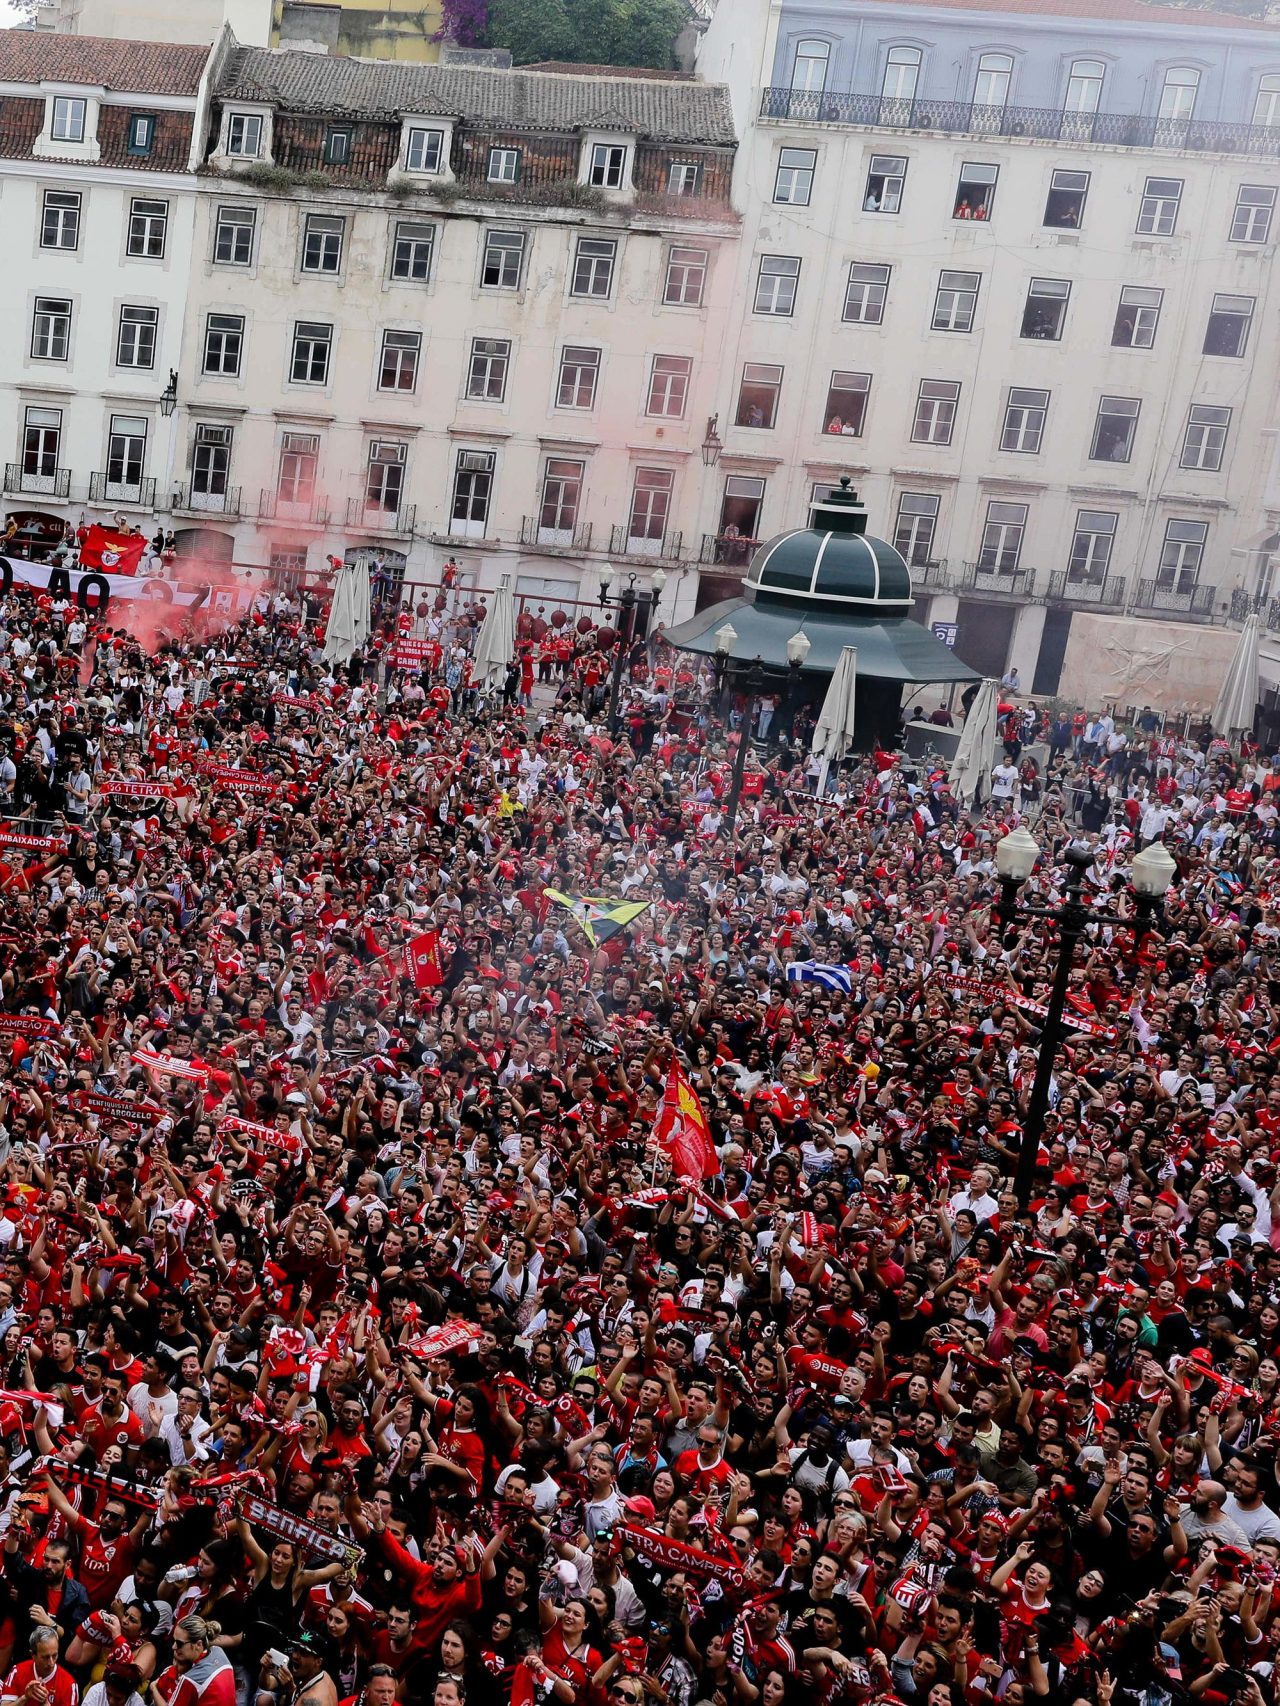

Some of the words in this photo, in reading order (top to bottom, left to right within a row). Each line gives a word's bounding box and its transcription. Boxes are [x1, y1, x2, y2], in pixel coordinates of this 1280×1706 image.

[46, 569, 111, 610] AO
[123, 784, 161, 795] TETRA
[222, 781, 273, 794] CAMPEÕES
[237, 1121, 286, 1148] TETRA
[249, 1500, 347, 1559] BENFICA
[616, 1526, 664, 1556] TETRA
[667, 1551, 743, 1591] CAMPEÃO
